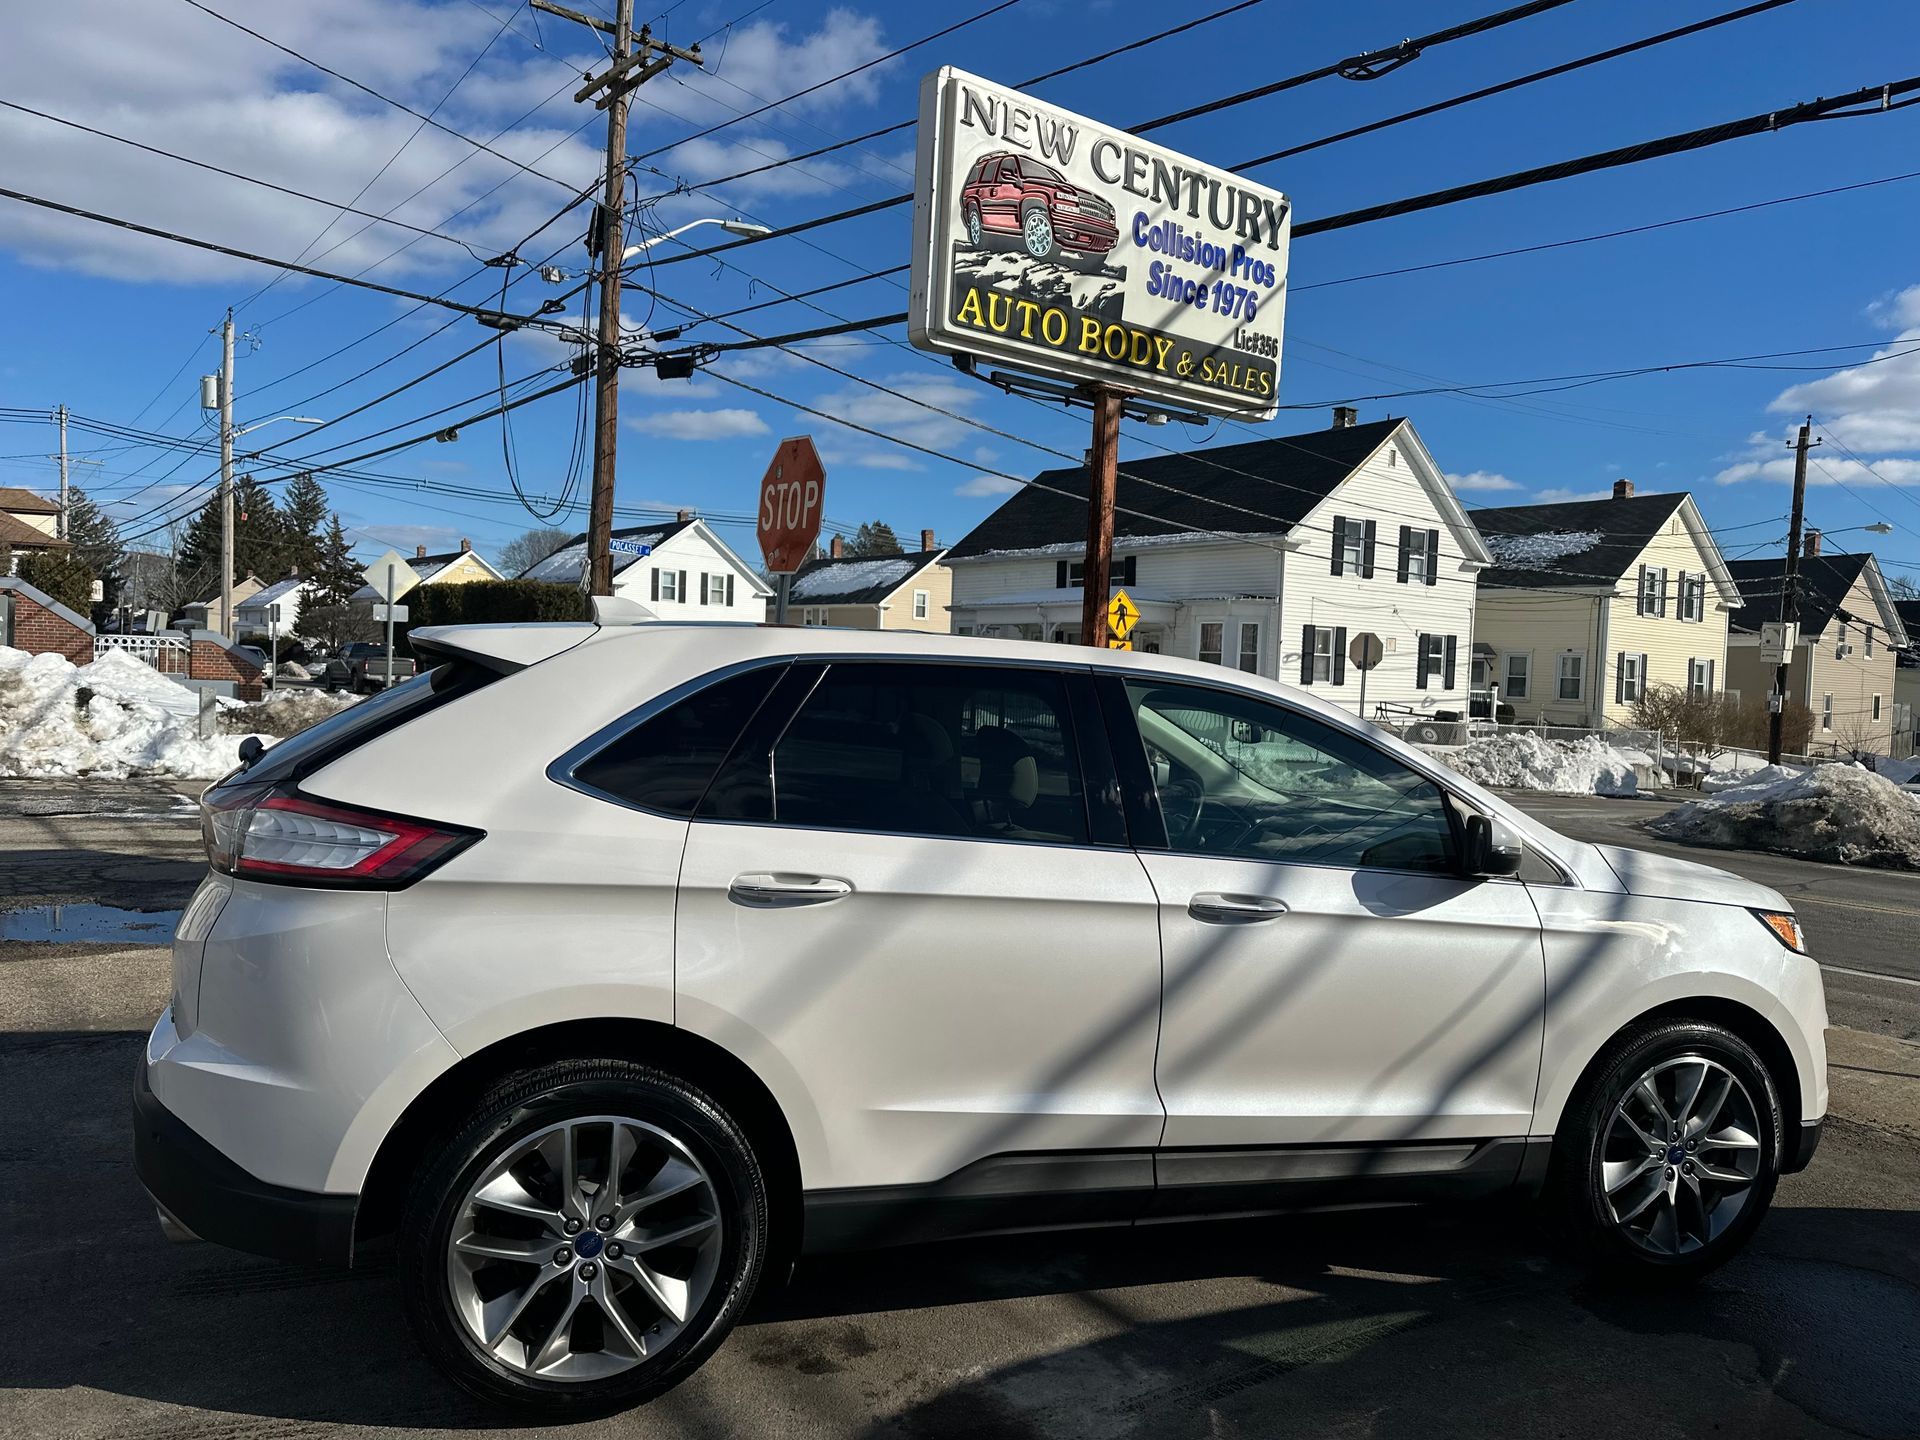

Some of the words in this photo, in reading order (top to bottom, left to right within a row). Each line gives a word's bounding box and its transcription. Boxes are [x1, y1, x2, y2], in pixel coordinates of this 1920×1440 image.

[960, 86, 1079, 166] NEW
[1090, 137, 1289, 251] CENTURY
[1132, 211, 1227, 272] Collision
[1230, 243, 1276, 289] Pros
[1146, 260, 1209, 310] Since
[1211, 280, 1259, 323] 1976
[956, 286, 1069, 346] AUTO
[1078, 315, 1176, 372] BODY
[1176, 351, 1196, 378] &
[1200, 356, 1273, 396] SALES
[1233, 326, 1279, 358] Lic#356
[762, 480, 819, 531] STOP
[612, 540, 643, 554] POCASSET
